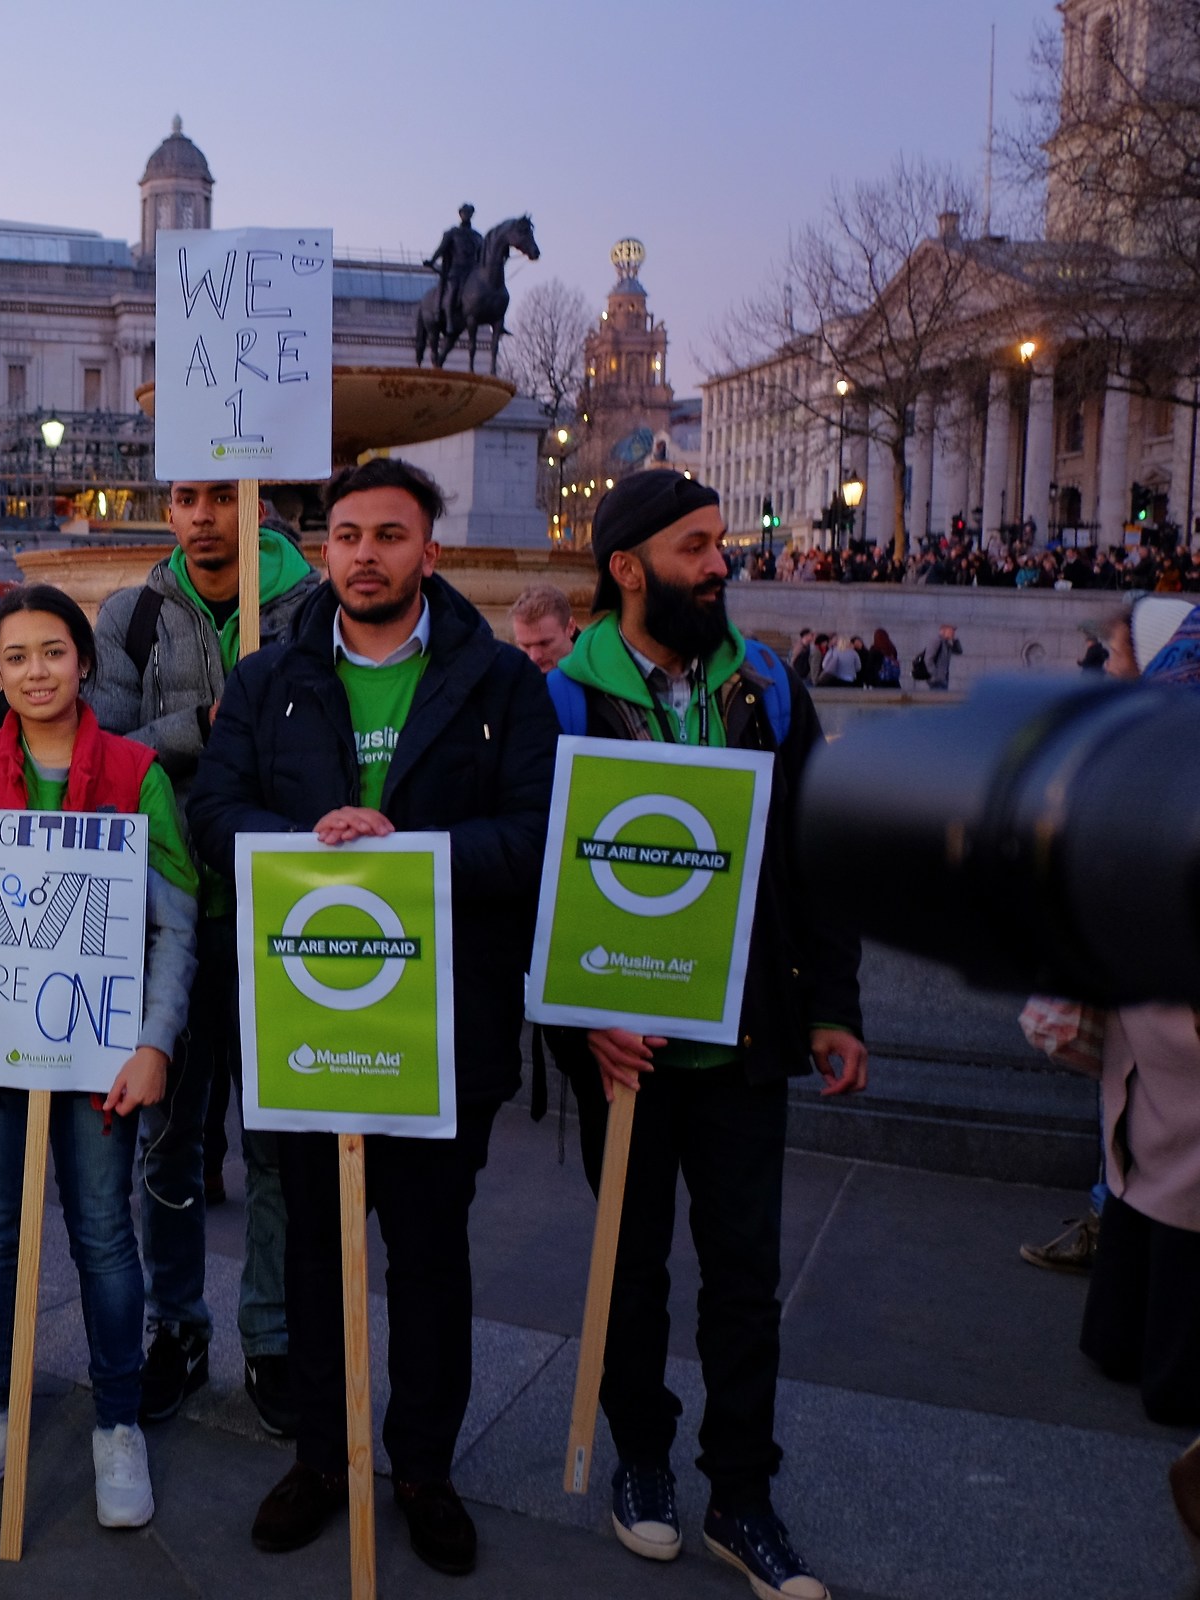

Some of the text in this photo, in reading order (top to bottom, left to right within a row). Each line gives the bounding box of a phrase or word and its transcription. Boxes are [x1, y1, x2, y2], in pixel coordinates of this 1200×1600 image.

[178, 247, 292, 320] WE
[185, 328, 309, 387] ARE
[210, 388, 264, 445] 1
[582, 842, 725, 868] WE ARE NOT AFRAID
[273, 939, 415, 956] WE ARE NOT AFRAID
[610, 951, 693, 973] Muslim Aid
[35, 971, 136, 1052] ONE
[316, 1049, 400, 1066] Muslim Aid
